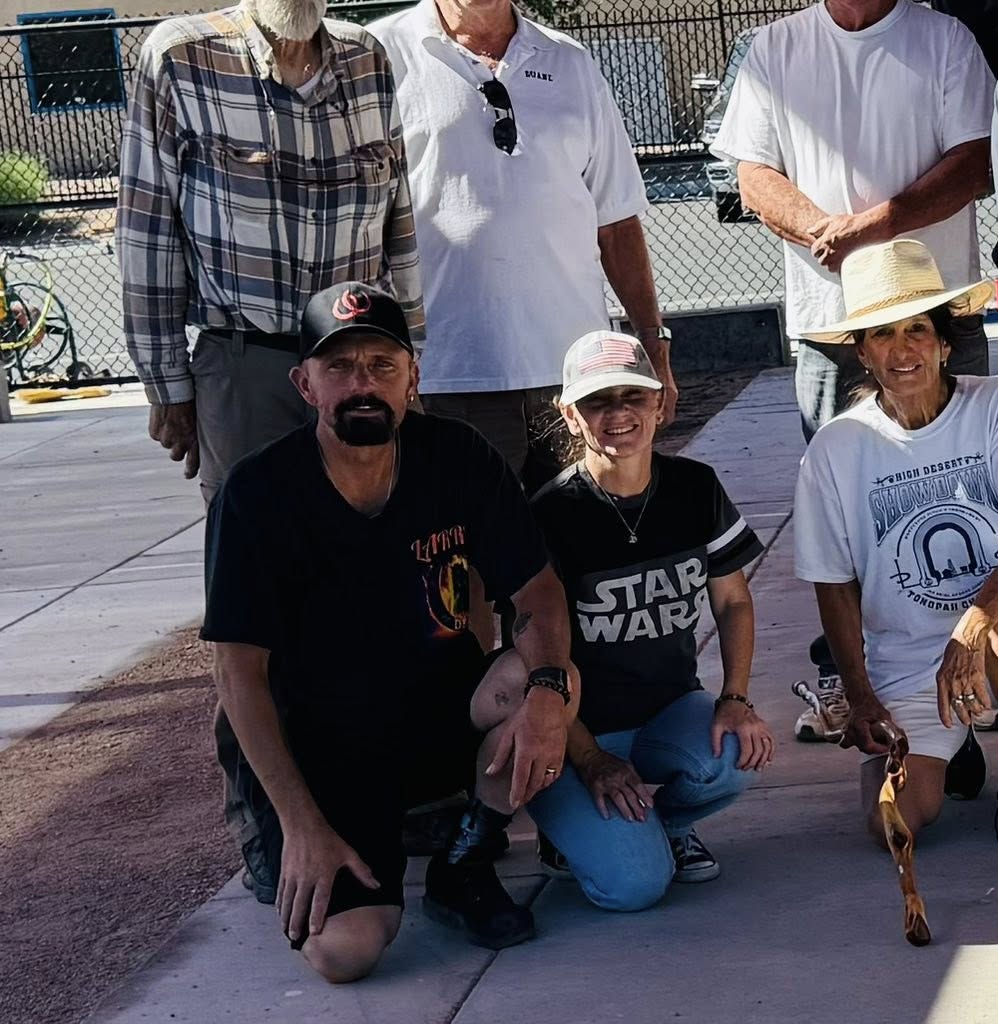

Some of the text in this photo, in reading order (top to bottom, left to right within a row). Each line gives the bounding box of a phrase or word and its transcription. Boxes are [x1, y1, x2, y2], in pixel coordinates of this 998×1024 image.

[895, 456, 963, 482] HIGH DESERT
[410, 524, 466, 563] LARR
[576, 557, 708, 613] STAR
